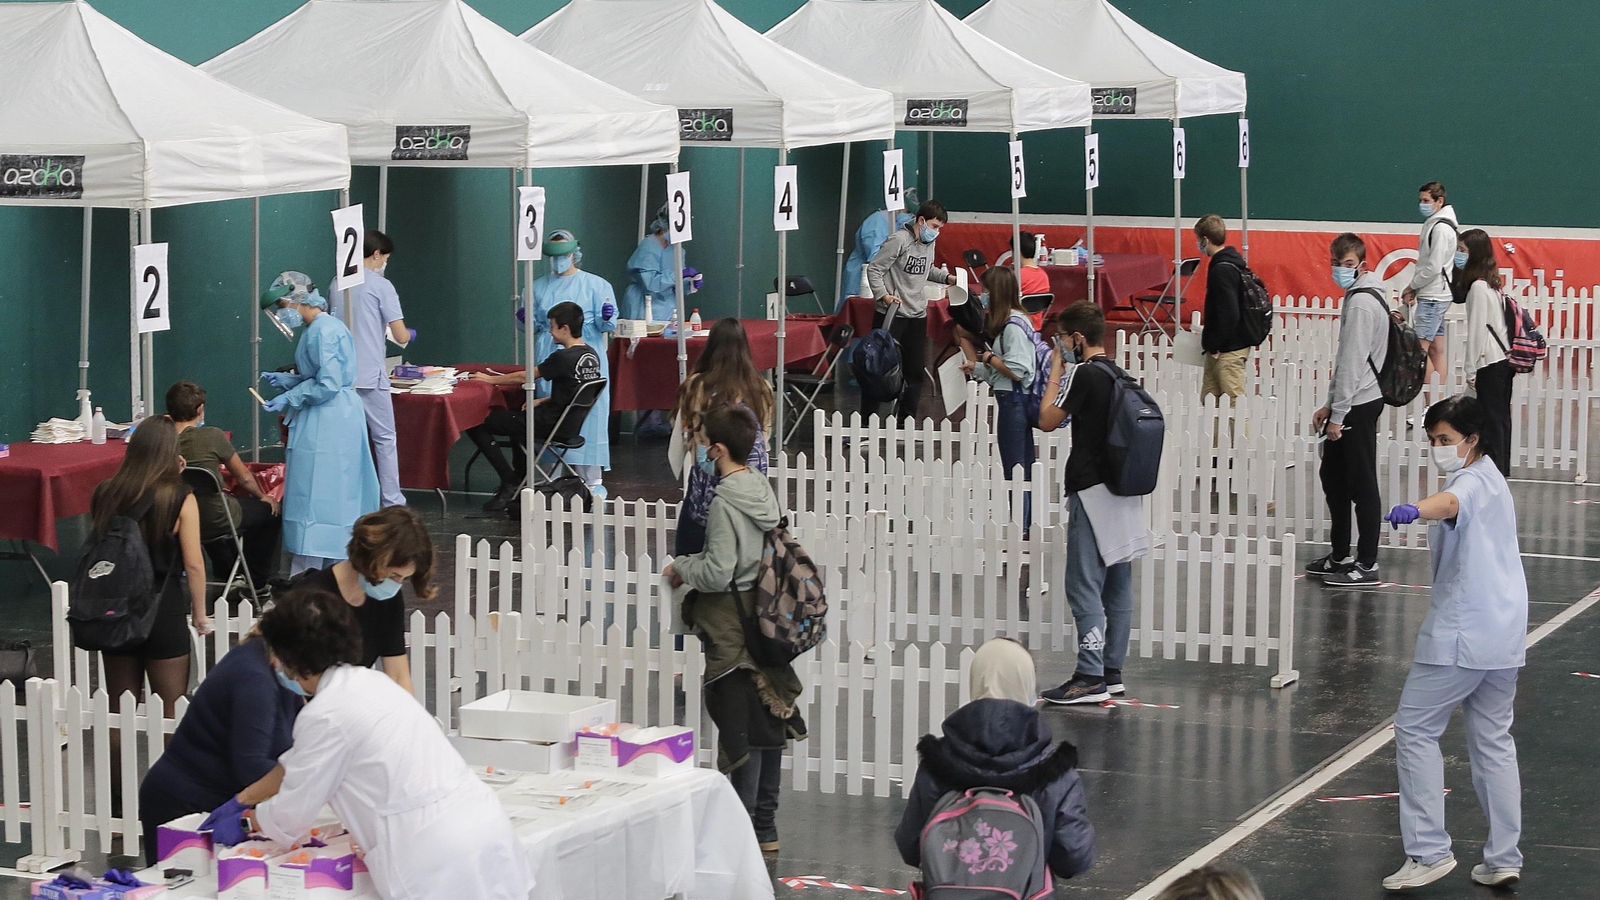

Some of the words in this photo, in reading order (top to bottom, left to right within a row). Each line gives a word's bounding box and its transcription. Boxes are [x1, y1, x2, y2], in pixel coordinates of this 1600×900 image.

[680, 112, 728, 132] zoka
[1177, 140, 1183, 171] 6
[1242, 131, 1248, 161] 6
[889, 164, 899, 201] 4
[1014, 155, 1021, 190] 5
[1089, 148, 1096, 181] 5
[673, 190, 686, 233] 3
[779, 181, 792, 221] 4
[525, 204, 538, 250] 3
[343, 227, 359, 277] 2
[143, 265, 161, 319] 2
[770, 301, 775, 319] 1
